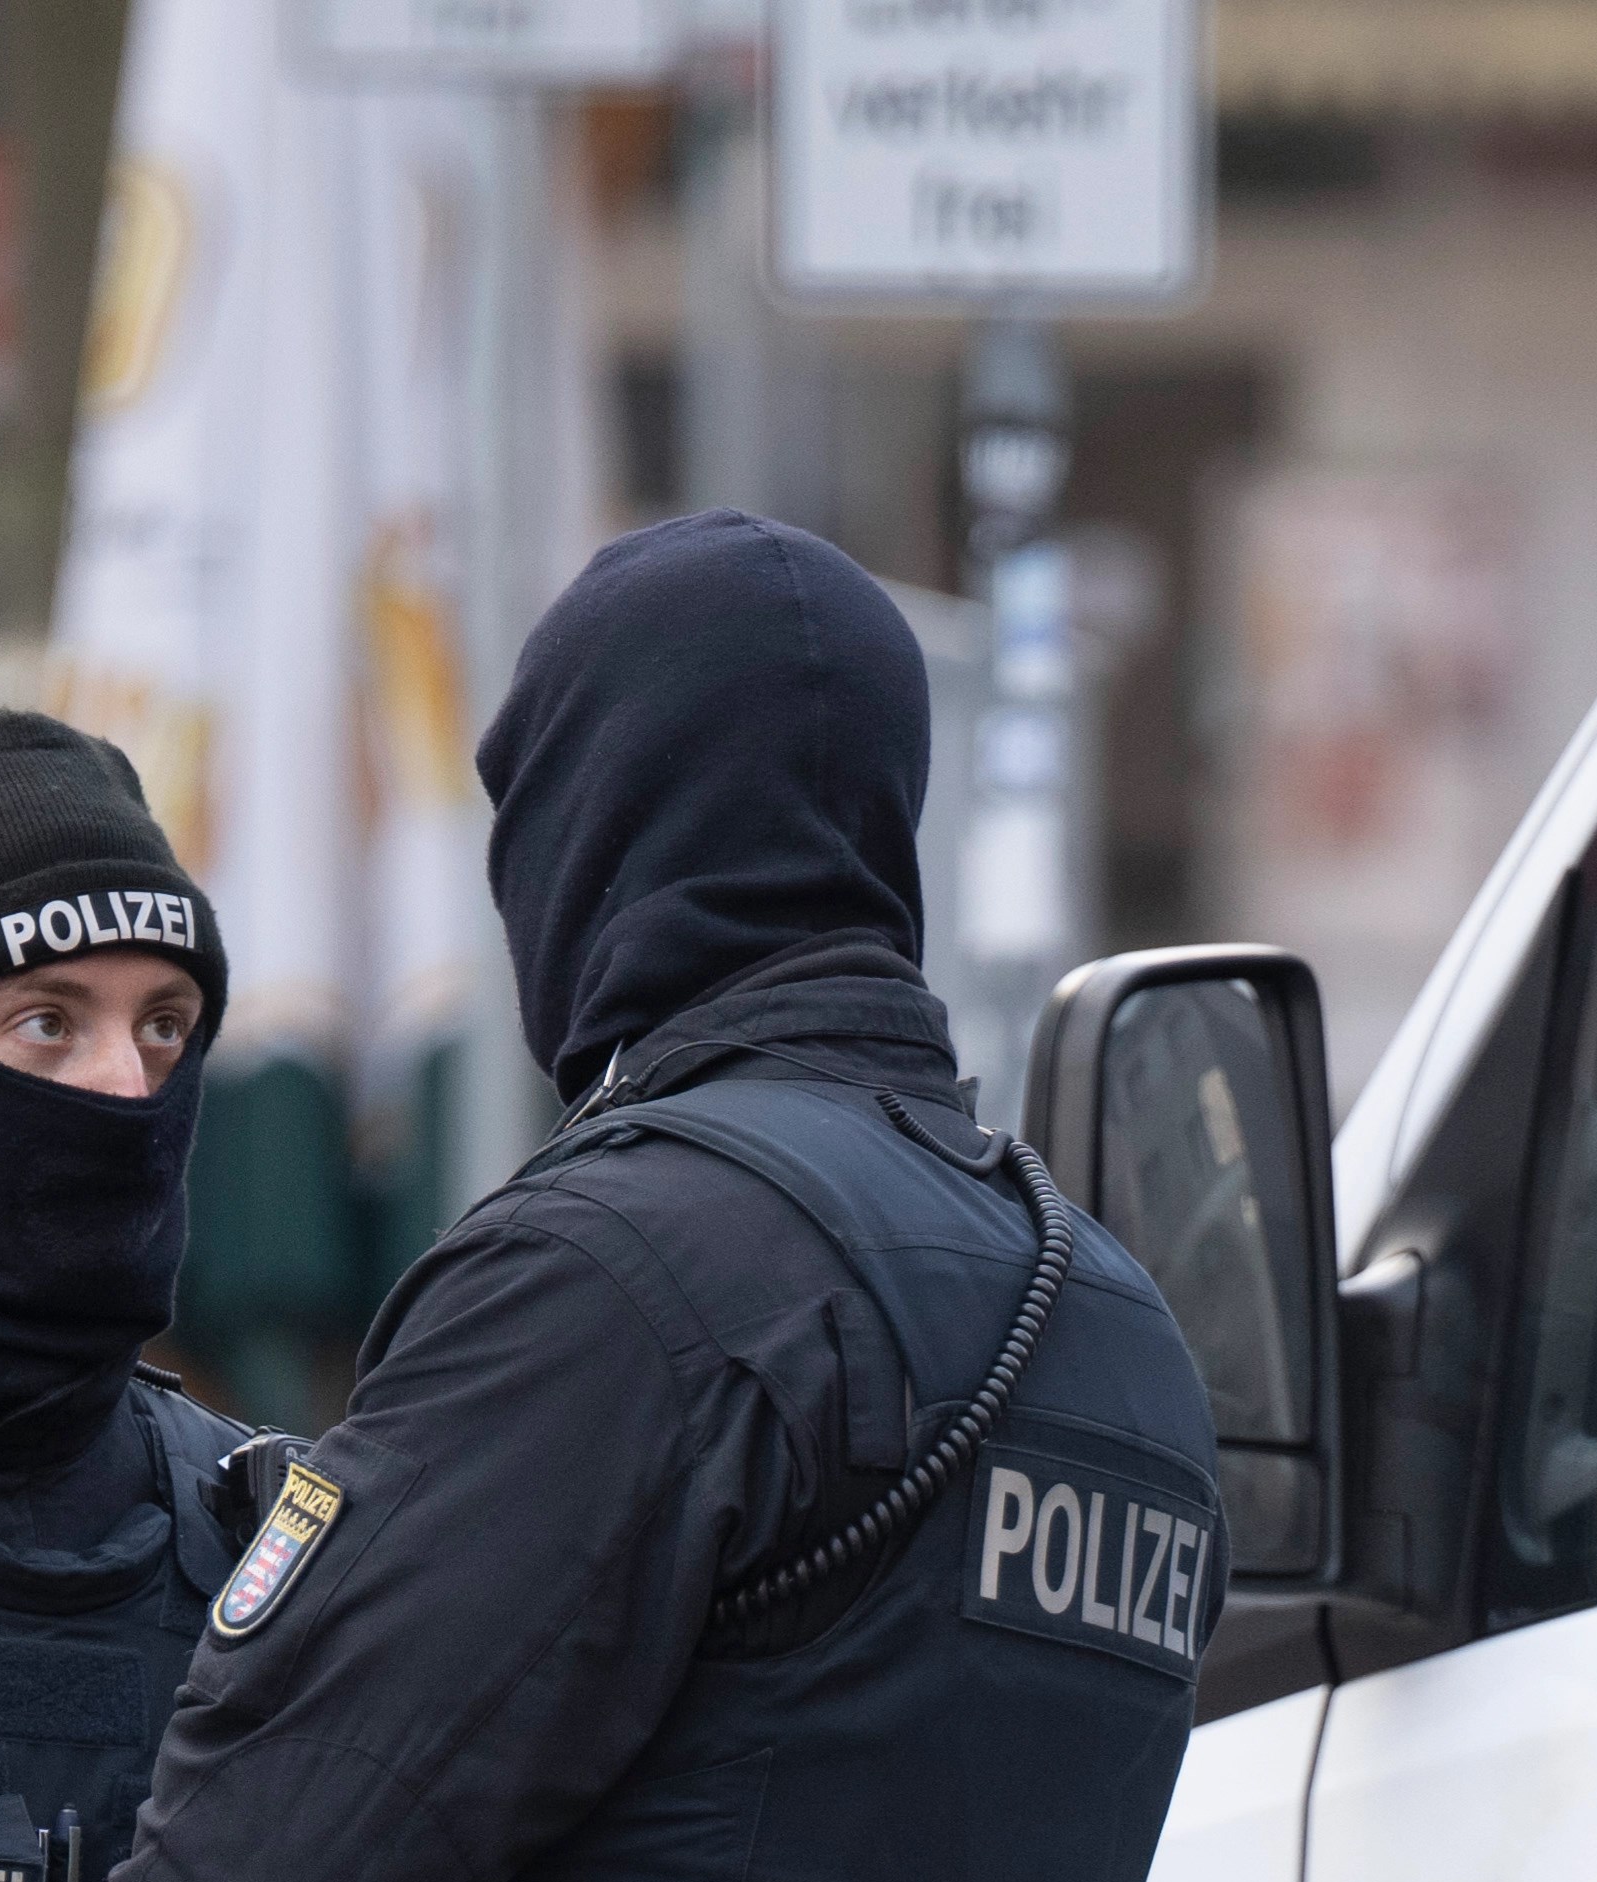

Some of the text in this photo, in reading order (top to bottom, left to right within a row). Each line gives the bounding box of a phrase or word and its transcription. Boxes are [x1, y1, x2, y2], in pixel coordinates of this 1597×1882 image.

[0, 890, 195, 967] POLIZEI
[284, 1473, 338, 1523] POLIZEI
[980, 1466, 1209, 1661] POLIZEI
